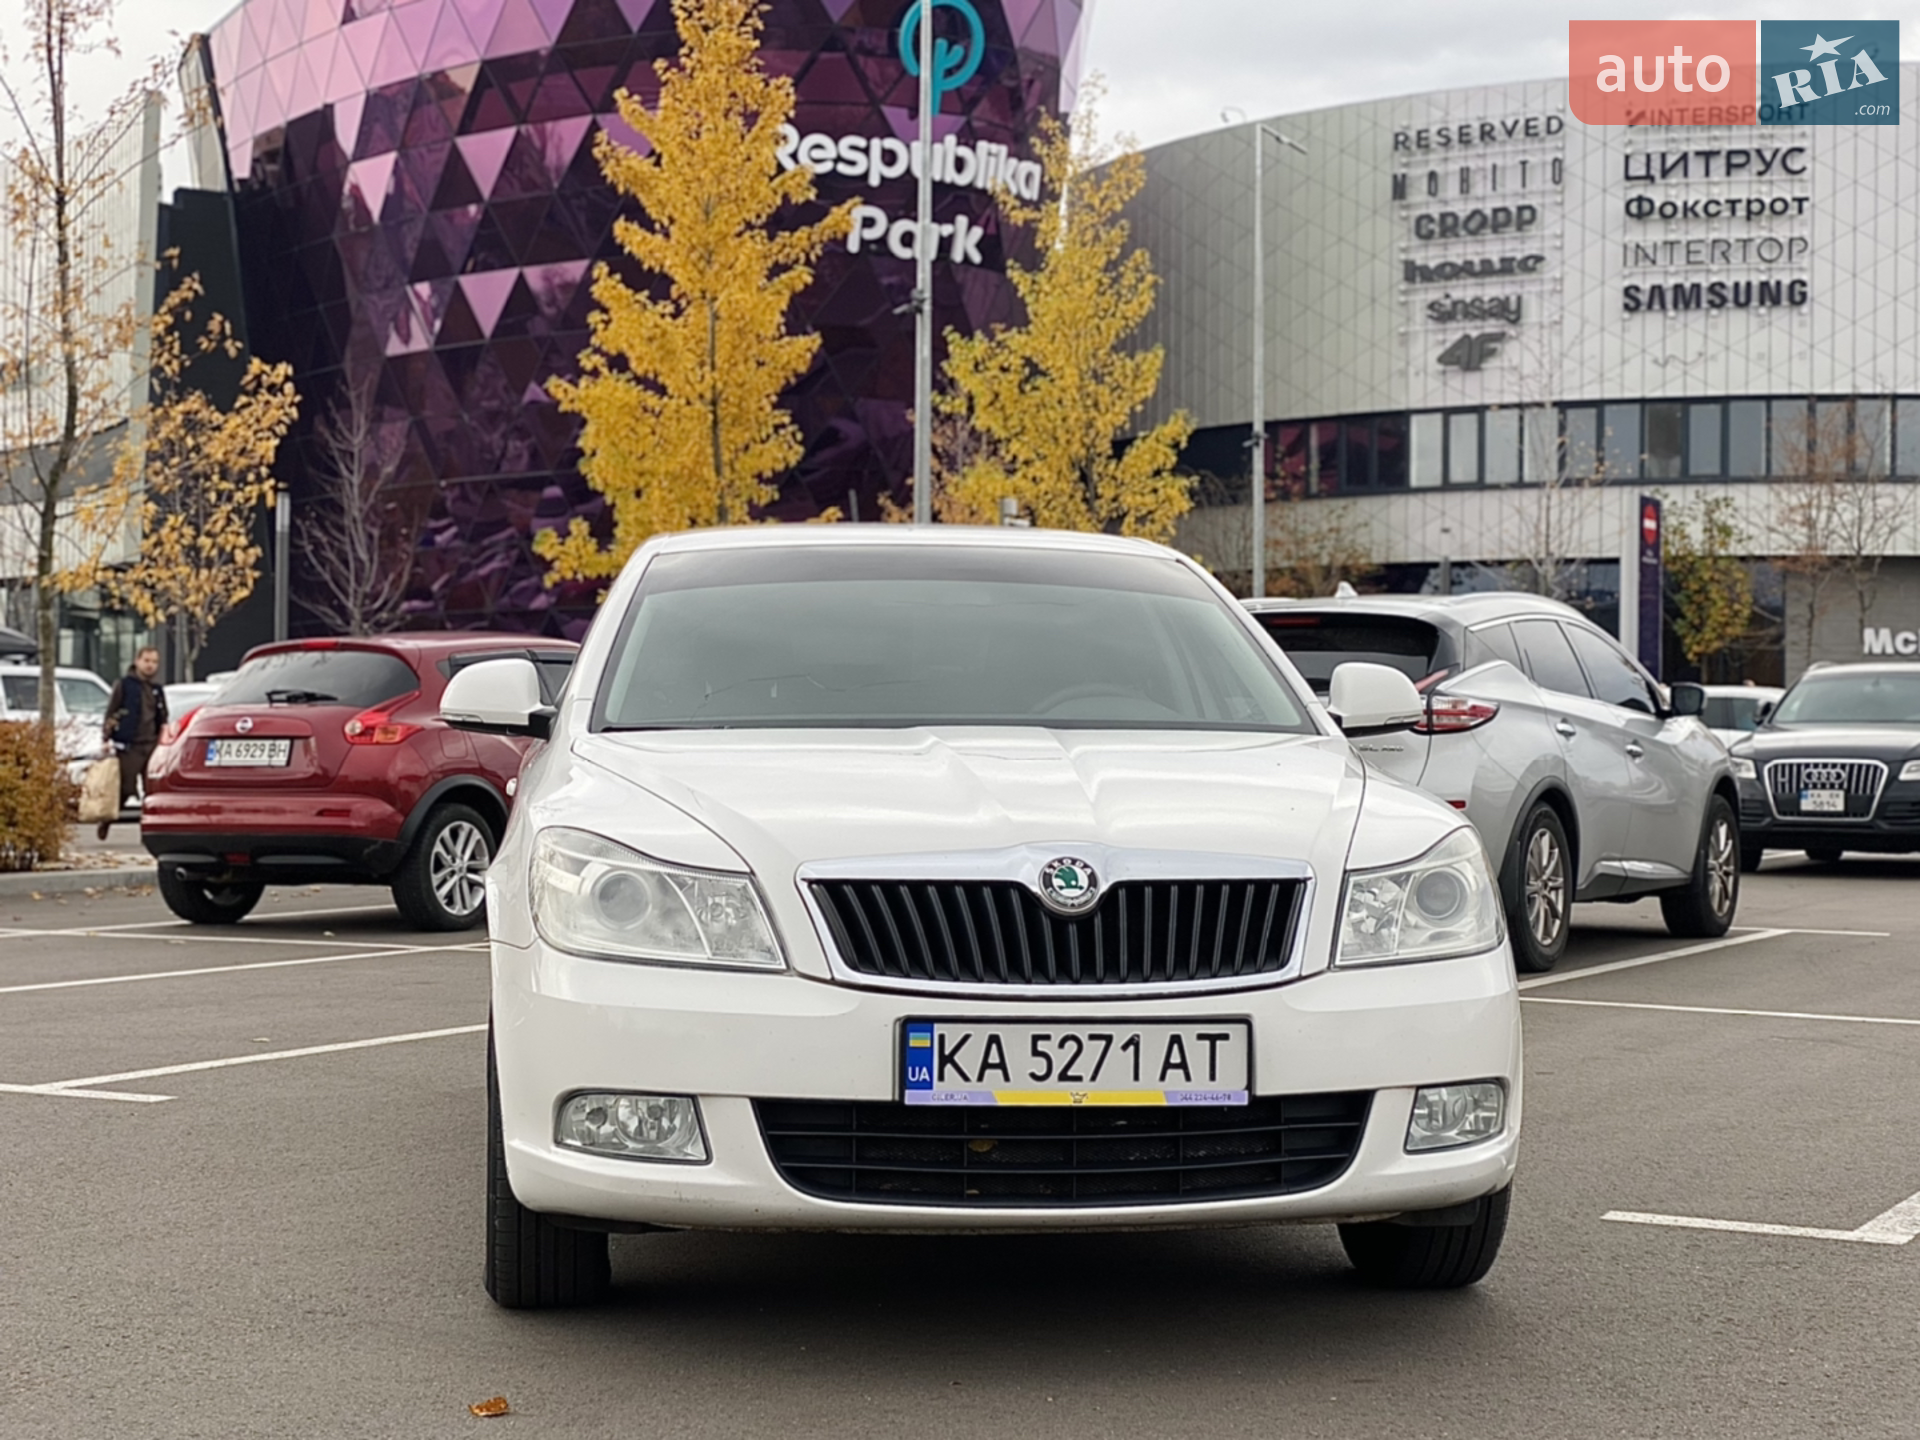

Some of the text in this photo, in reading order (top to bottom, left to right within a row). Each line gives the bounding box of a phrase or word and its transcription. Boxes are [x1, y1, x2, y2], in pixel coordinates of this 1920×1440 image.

[1394, 115, 1564, 151] RESERVED
[774, 123, 1042, 200] Respublika
[1623, 147, 1807, 184] ЦИТРУС
[1414, 204, 1537, 241] CROPP
[1624, 194, 1809, 222] Фокстрот
[846, 204, 984, 264] Park
[1622, 236, 1808, 269] INTERTOP
[1427, 293, 1522, 324] sinsay
[1622, 279, 1808, 313] SAMSUNG
[1862, 627, 1920, 655] Mc
[235, 743, 266, 759] 6929
[908, 1067, 931, 1082] UA
[937, 1033, 1230, 1083] KA 5271 AT
